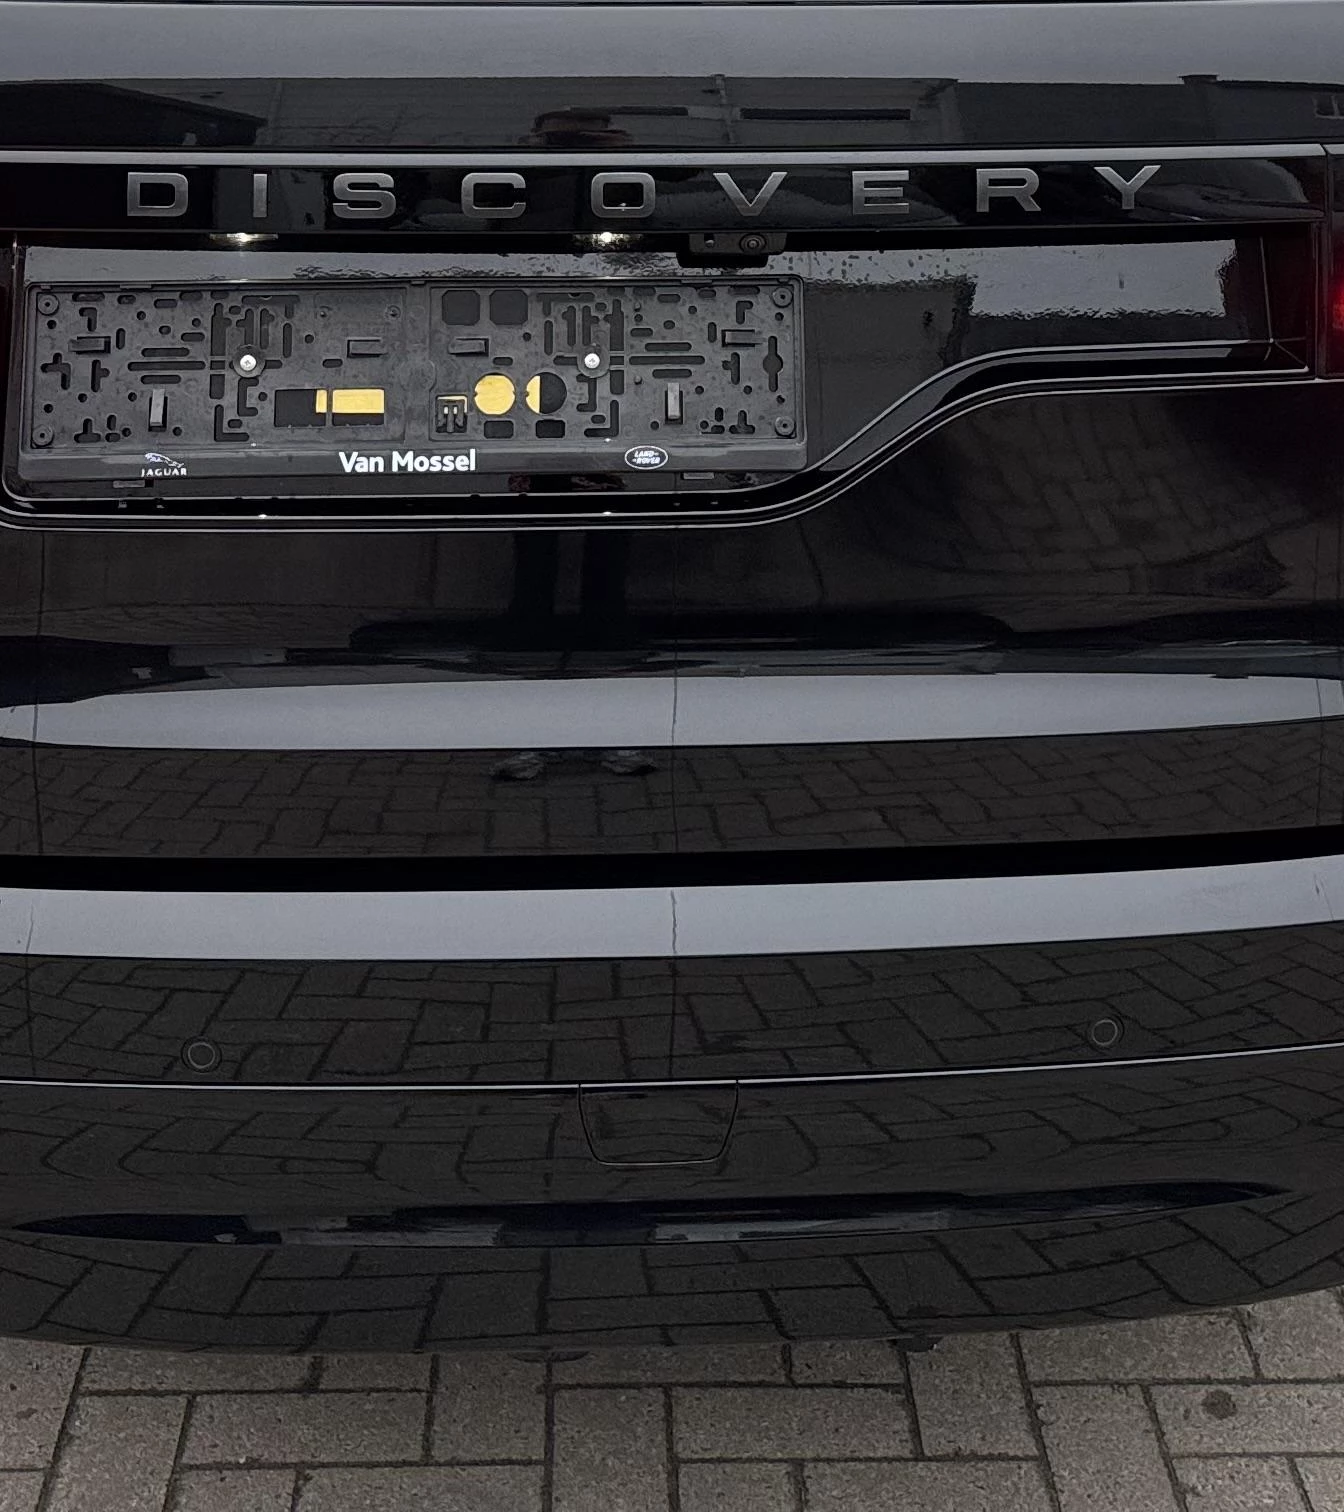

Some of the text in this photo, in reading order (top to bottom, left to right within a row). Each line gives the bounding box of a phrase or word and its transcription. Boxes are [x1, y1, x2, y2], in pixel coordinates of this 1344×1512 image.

[127, 165, 1162, 219] DISCOVERY
[140, 467, 188, 478] JAGUAR
[338, 448, 476, 473] Van Mossel
